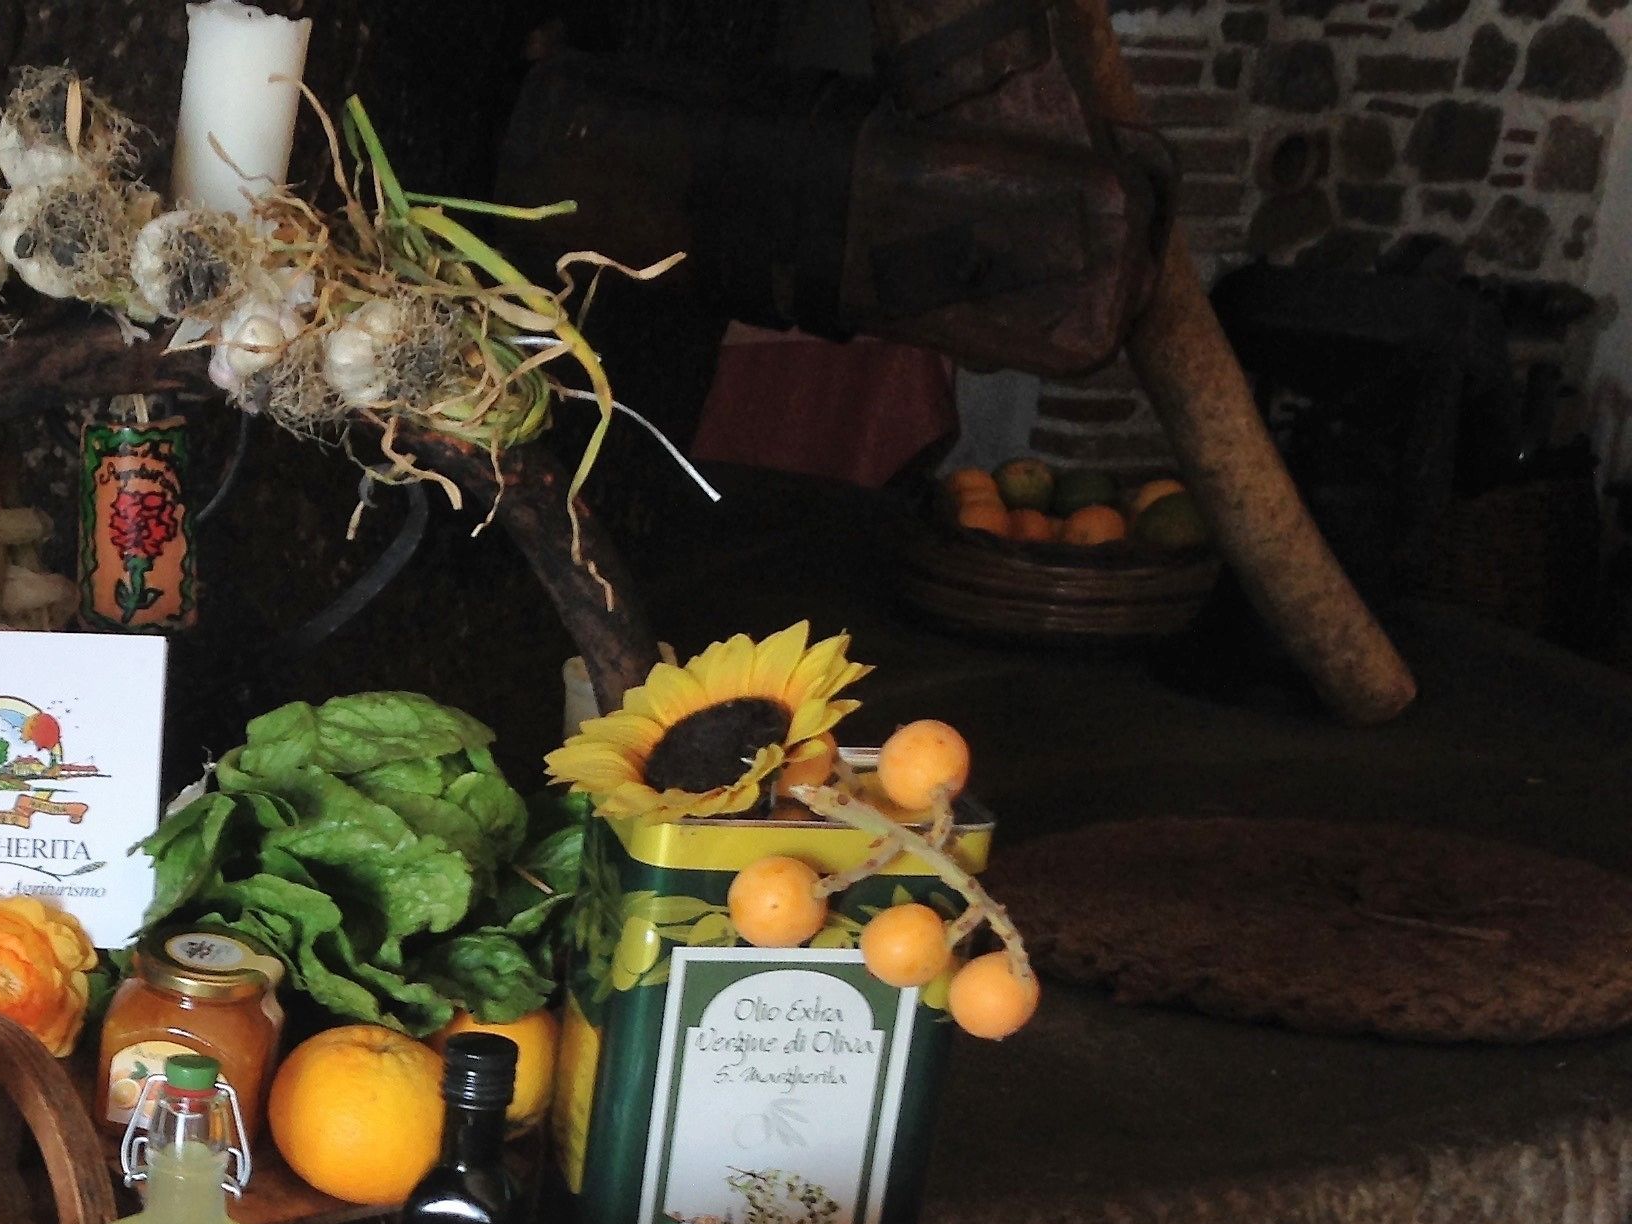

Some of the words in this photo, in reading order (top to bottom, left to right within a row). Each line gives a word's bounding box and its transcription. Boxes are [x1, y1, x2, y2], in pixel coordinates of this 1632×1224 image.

[734, 995, 782, 1022] Olio
[785, 994, 845, 1023] Extra
[694, 1027, 779, 1068] Vergine
[782, 1027, 807, 1054] di
[811, 1028, 875, 1055] Oliva
[738, 1064, 848, 1094] Margherita
